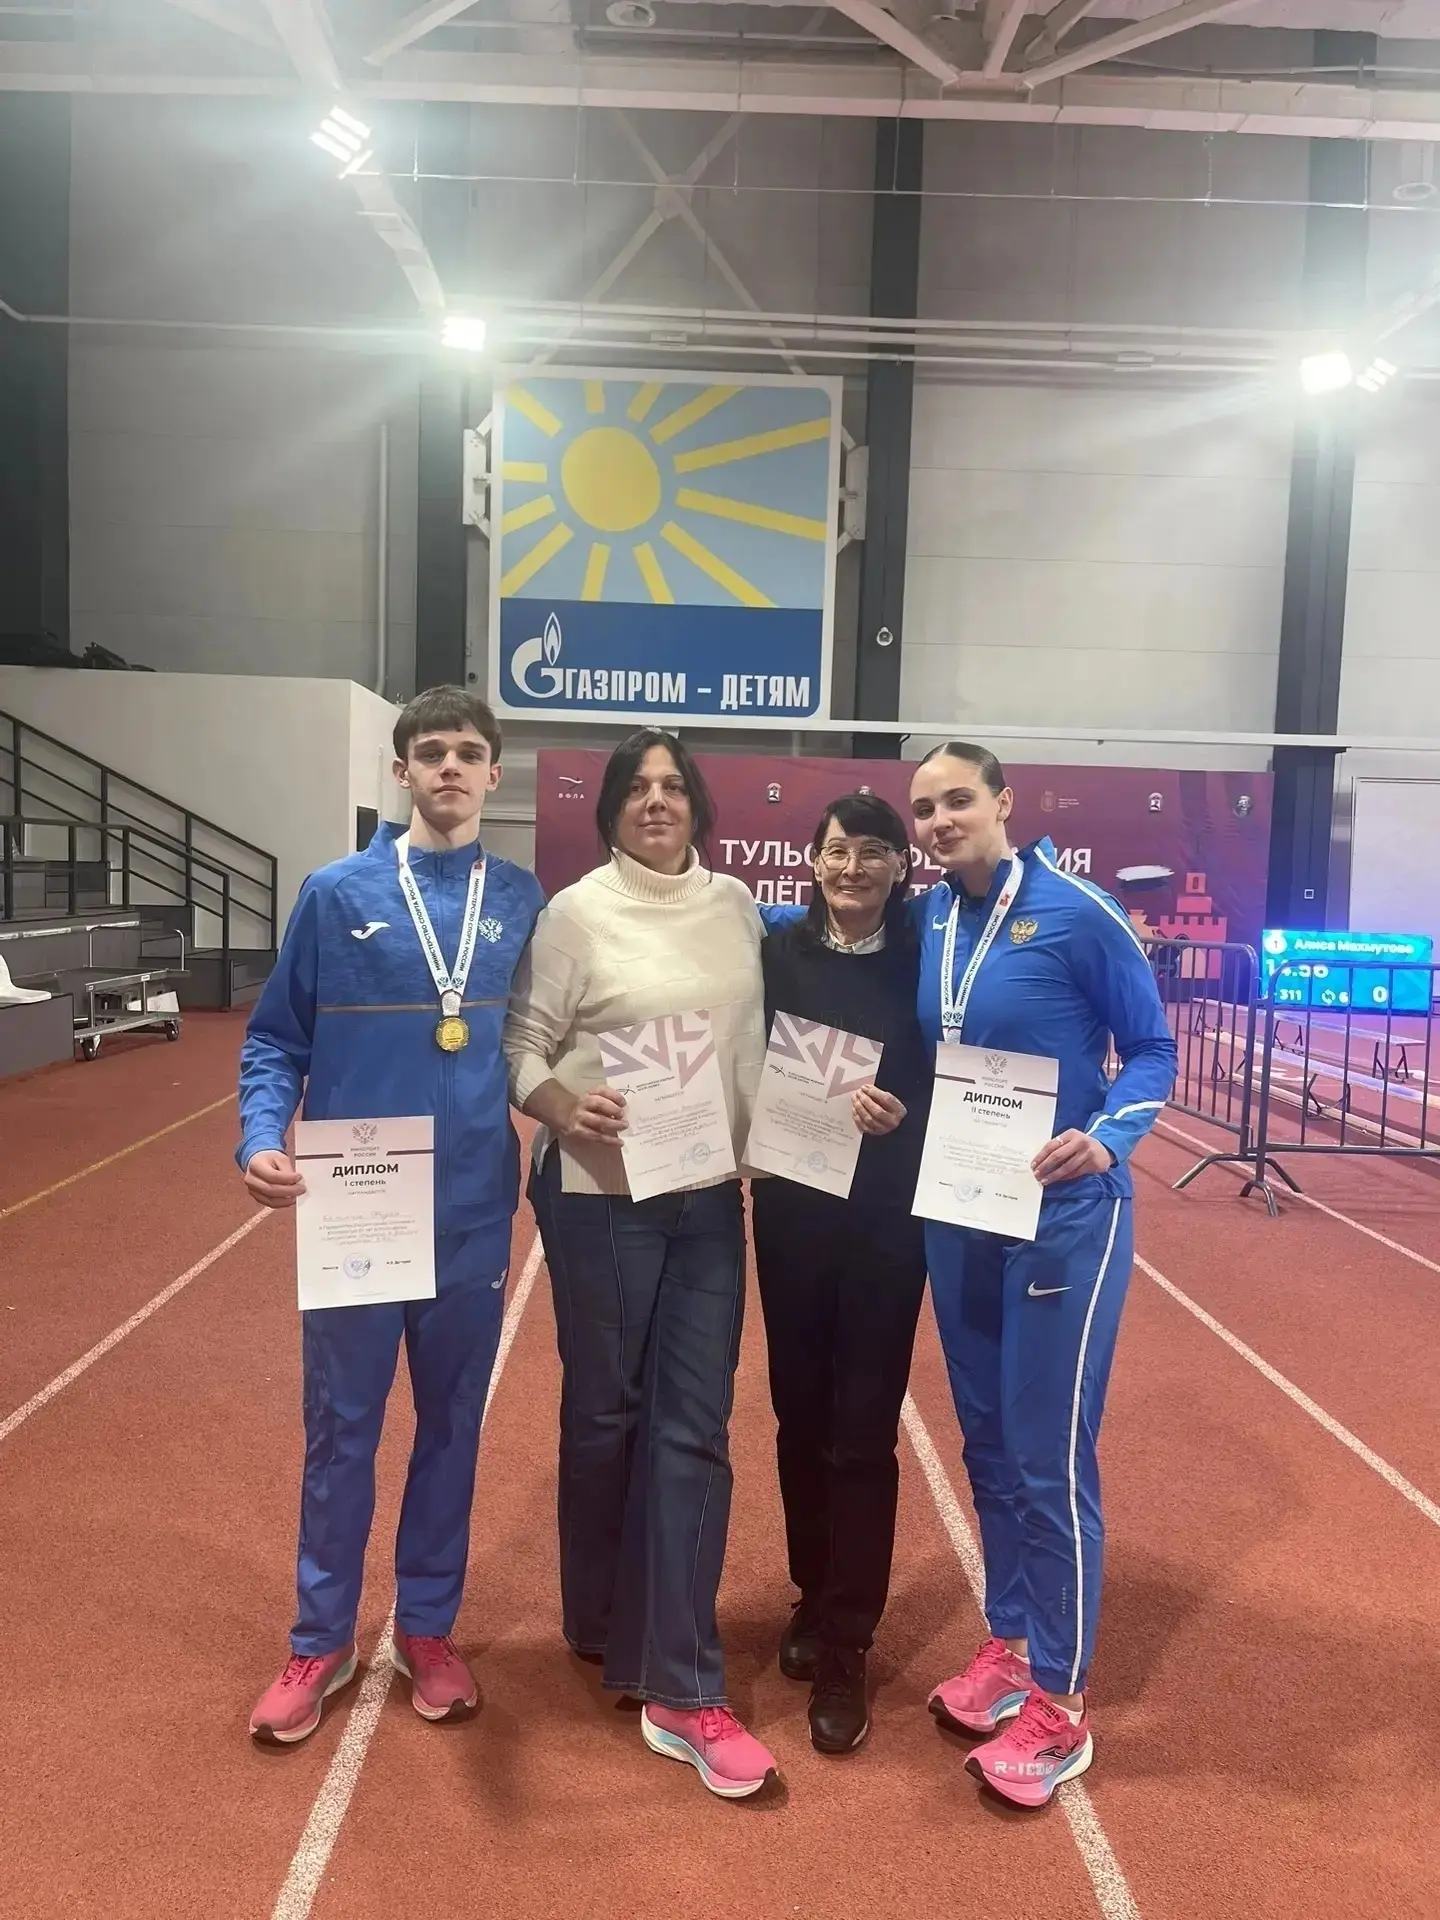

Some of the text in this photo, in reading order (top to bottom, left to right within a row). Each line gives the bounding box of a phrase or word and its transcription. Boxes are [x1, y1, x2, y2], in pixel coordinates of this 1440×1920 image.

[565, 668, 686, 704] ГАЗПРОМ
[720, 673, 810, 710] ДЕТЯМ
[1279, 988, 1302, 1001] 311
[1372, 985, 1389, 1003] 0
[963, 1091, 1023, 1110] ДИПЛОМ
[977, 1107, 1011, 1120] степень
[332, 1163, 399, 1178] ДИПЛОМ
[349, 1179, 387, 1187] степень
